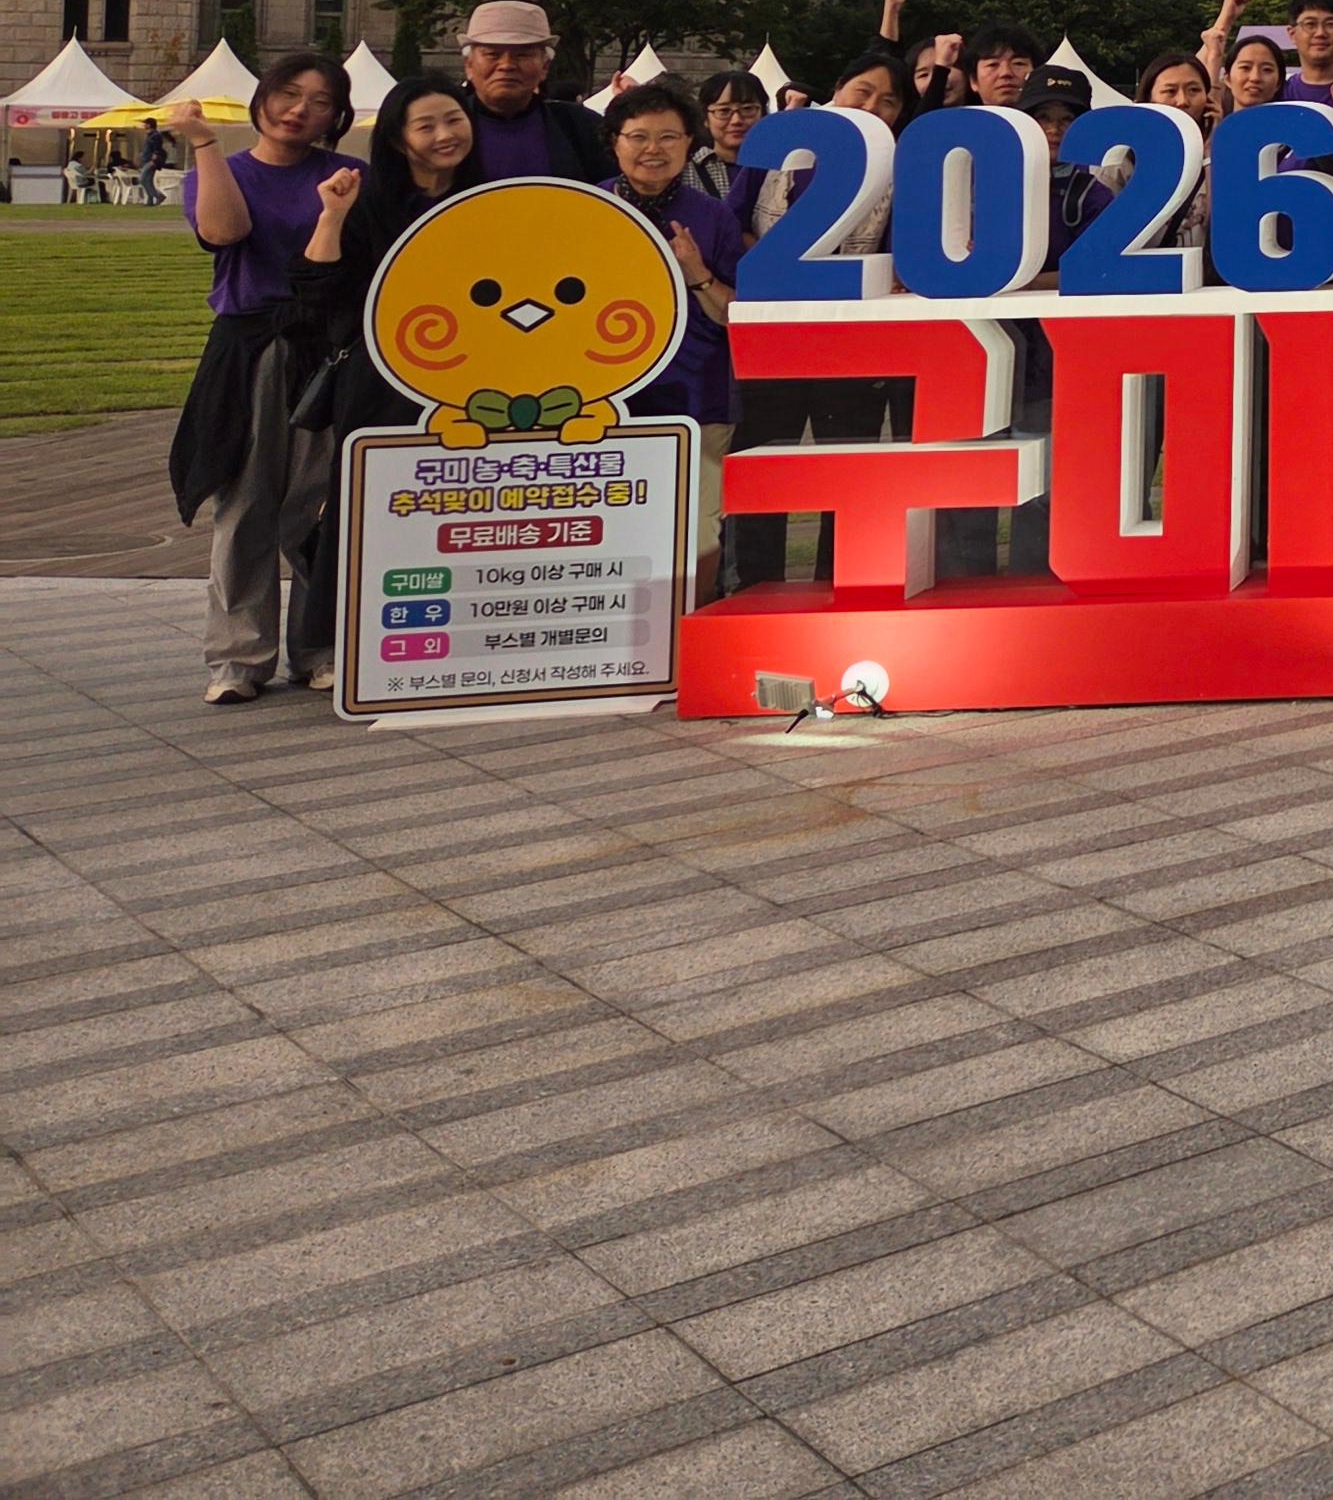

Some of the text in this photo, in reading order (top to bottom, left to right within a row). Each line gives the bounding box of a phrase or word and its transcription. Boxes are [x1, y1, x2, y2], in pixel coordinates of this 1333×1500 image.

[416, 457, 470, 485] 구미
[389, 487, 492, 516] 추석맞이
[498, 483, 600, 511] 예약접수
[449, 520, 593, 549] 무료배송 기준
[391, 572, 445, 592] 구미쌀
[476, 561, 624, 586] 10kg 이상 구매 시
[470, 593, 626, 618] 10만원 이상 구매 시
[484, 627, 608, 650] 부스별 개별문의
[409, 672, 456, 692] 부스별
[460, 670, 496, 688] 문의,
[500, 666, 546, 684] 신청서
[551, 662, 596, 681] 작성해
[600, 660, 650, 678] 주세요.
